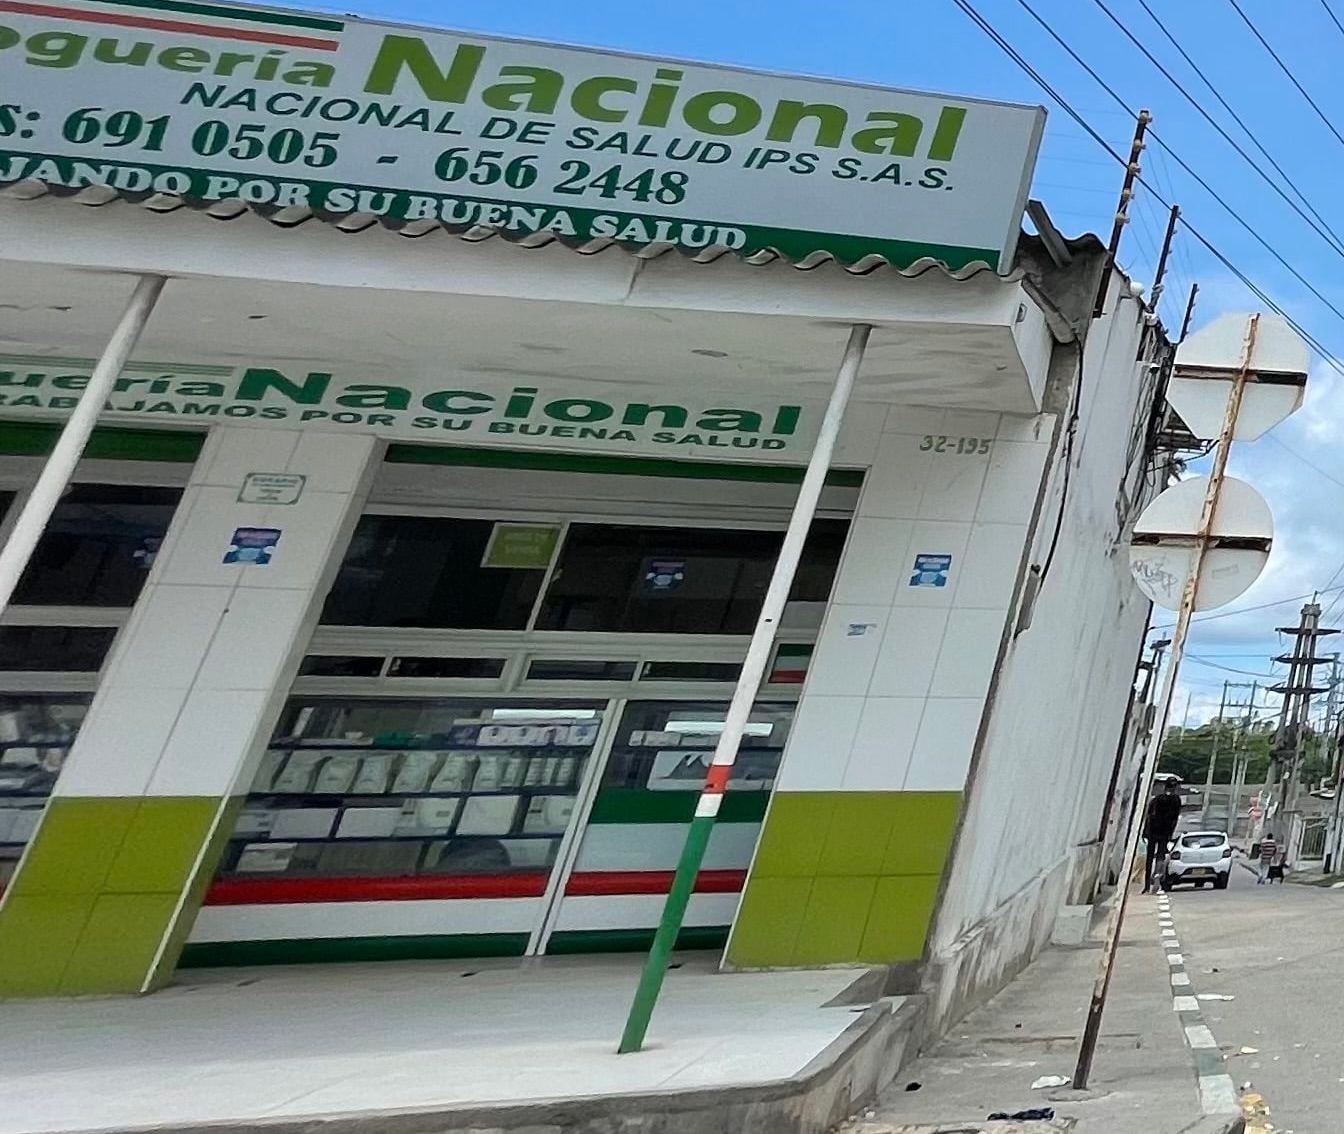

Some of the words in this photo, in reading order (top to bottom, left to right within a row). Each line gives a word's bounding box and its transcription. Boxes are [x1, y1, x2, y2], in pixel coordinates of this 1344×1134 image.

[363, 34, 968, 162] Nacional
[62, 107, 172, 152] 691
[191, 120, 341, 168] 0505
[434, 147, 540, 189] 656
[553, 160, 690, 205] 2448
[180, 82, 462, 135] NACIONAL
[479, 116, 556, 145] DE
[565, 126, 732, 164] SALUD
[743, 147, 820, 175] IPS
[831, 157, 954, 191] S.A.S.
[202, 176, 310, 207] POR
[324, 187, 396, 216] SU
[404, 195, 578, 237] BUENA
[589, 214, 747, 250] SALUD
[0, 394, 288, 420] ABJAMOS
[301, 410, 397, 427] POR
[411, 416, 473, 432] SU
[488, 421, 637, 442] BUENA
[651, 432, 787, 451] SALUD
[235, 367, 803, 436] Nacional
[919, 434, 993, 455] 32-195
